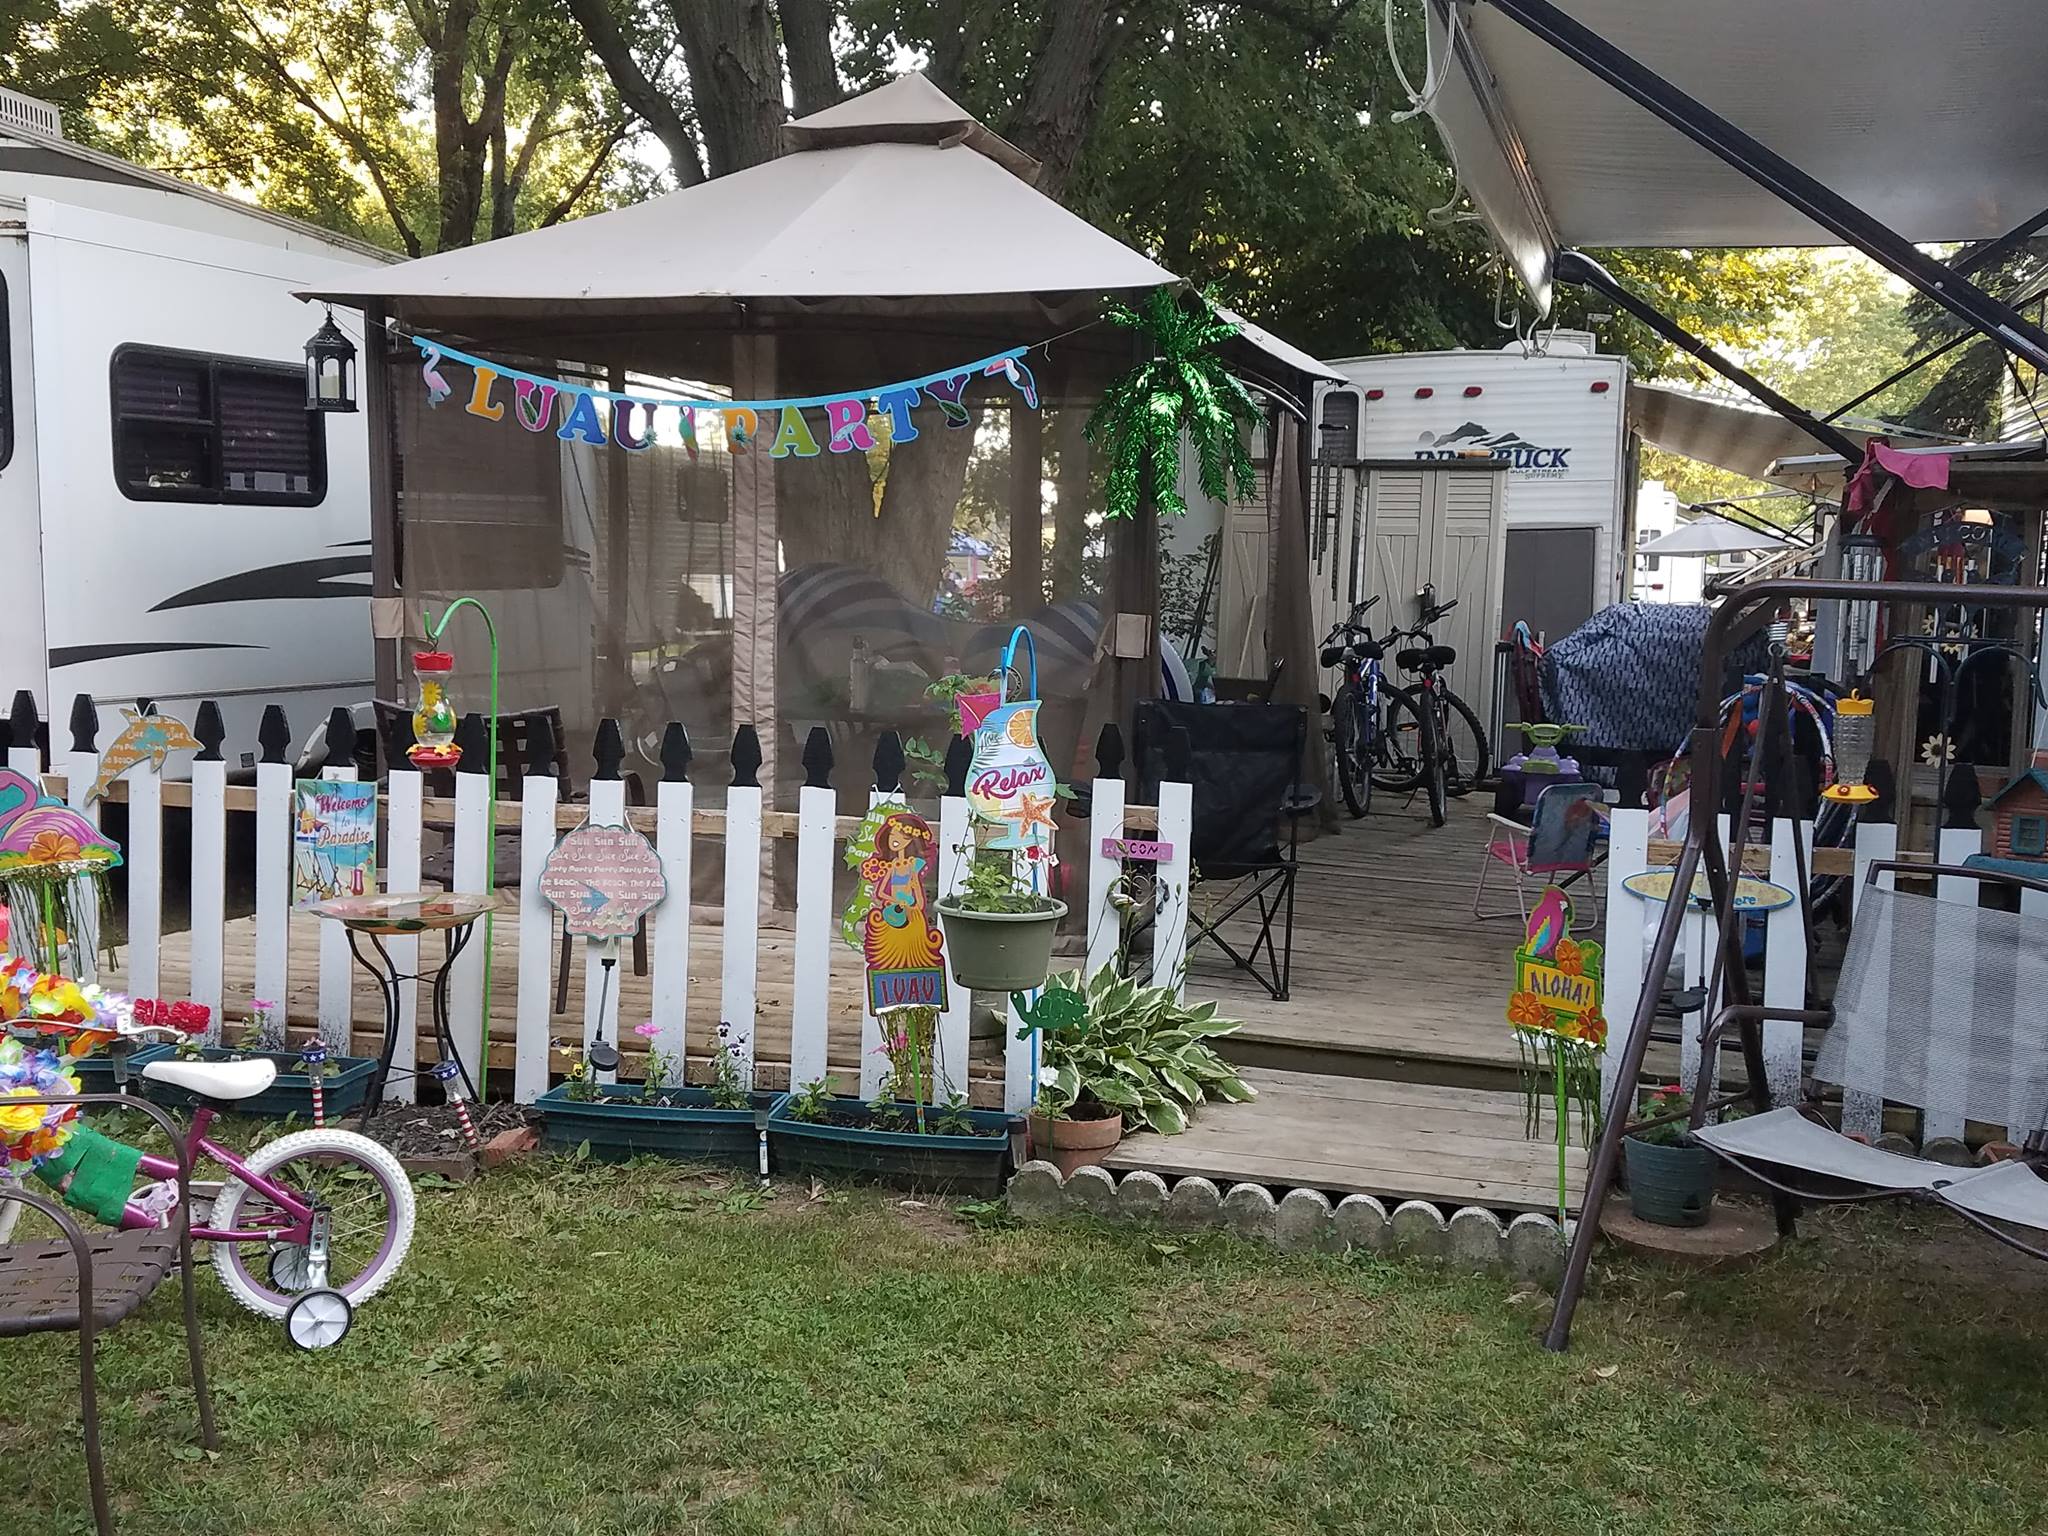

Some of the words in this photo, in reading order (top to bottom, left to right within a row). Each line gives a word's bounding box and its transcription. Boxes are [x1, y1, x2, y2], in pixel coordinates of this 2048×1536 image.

[465, 365, 658, 452] LUAU
[724, 373, 971, 458] PARTY
[972, 766, 1046, 800] Relax
[315, 793, 368, 814] Welcome
[341, 816, 352, 827] to
[318, 826, 370, 848] Paradise
[594, 837, 614, 846] Sun
[618, 837, 638, 846] Sun
[619, 848, 639, 862] Sue
[545, 889, 566, 898] Sun
[619, 890, 637, 900] Sun
[642, 891, 660, 900] Sun
[881, 975, 935, 1005] LUAU
[1530, 970, 1591, 1007] ALOHA!
